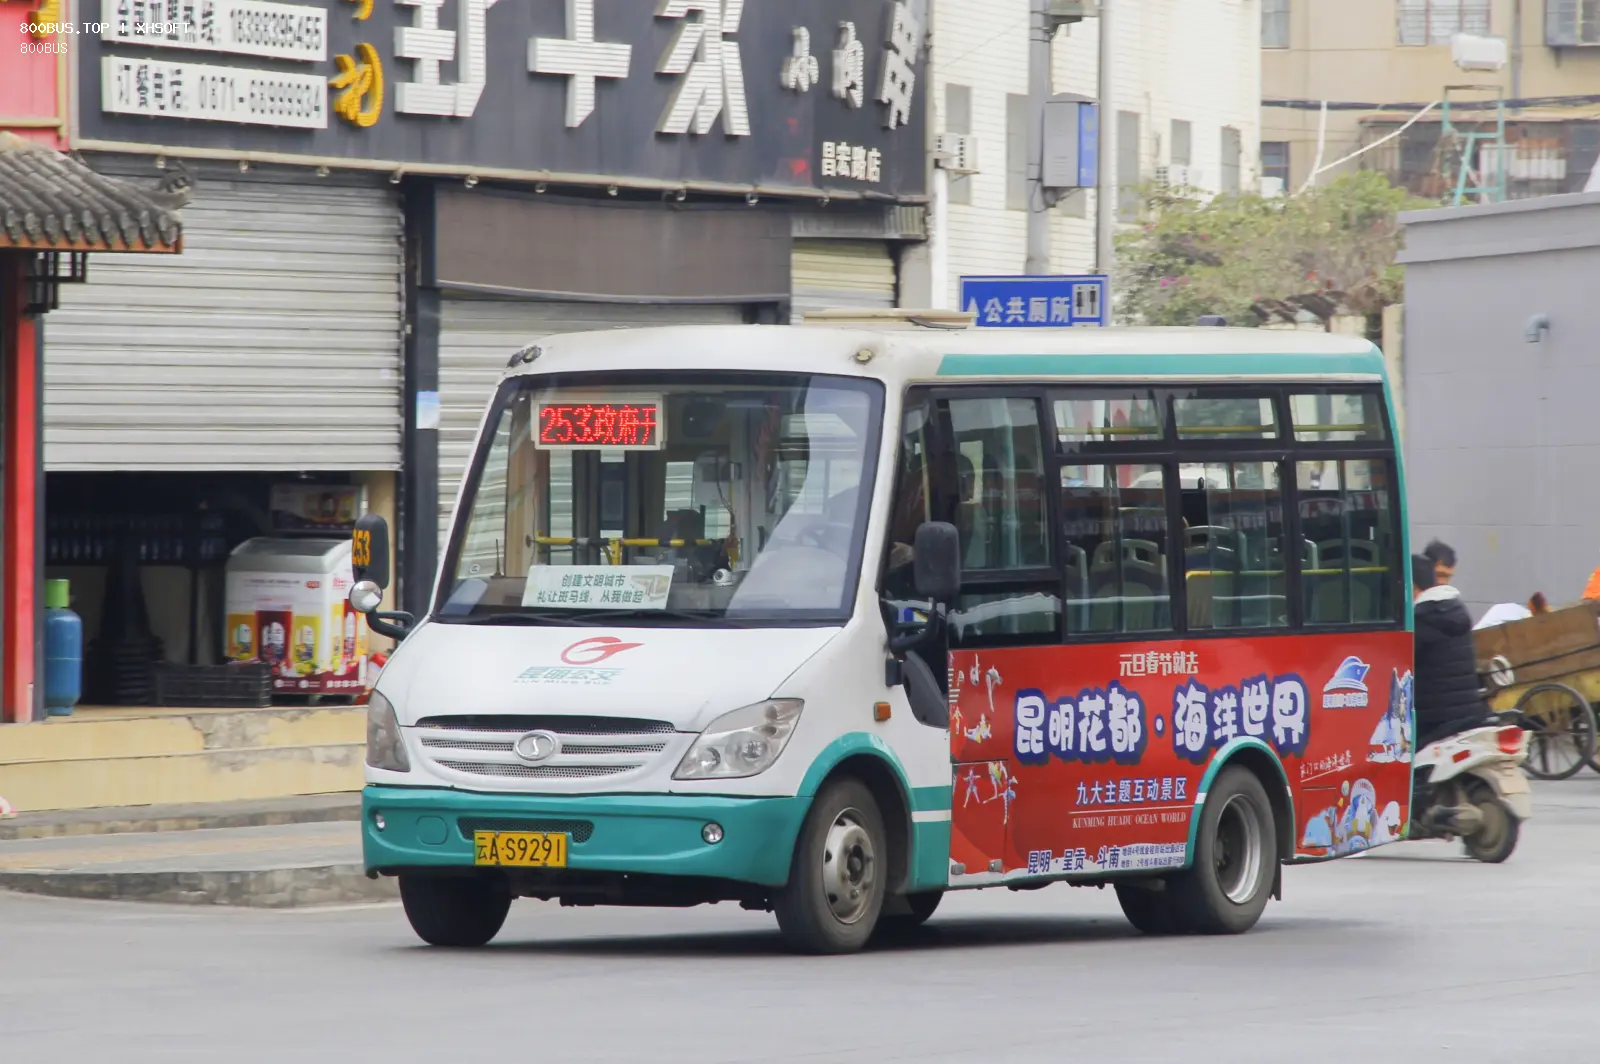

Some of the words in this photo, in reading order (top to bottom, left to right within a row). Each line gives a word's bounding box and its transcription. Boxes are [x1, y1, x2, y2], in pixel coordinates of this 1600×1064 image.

[984, 296, 1071, 323] 公共厕所
[561, 574, 625, 587] 创建文明城市
[1119, 650, 1199, 677] 元旦春节就去
[1016, 680, 1305, 754] 昆明花都·海洋世界
[1076, 777, 1188, 806] 九大主题互动景区
[1072, 816, 1105, 829] KUNMING
[1107, 815, 1133, 827] HUADU
[1135, 814, 1158, 825] OCEAN
[1160, 812, 1187, 823] WORLD
